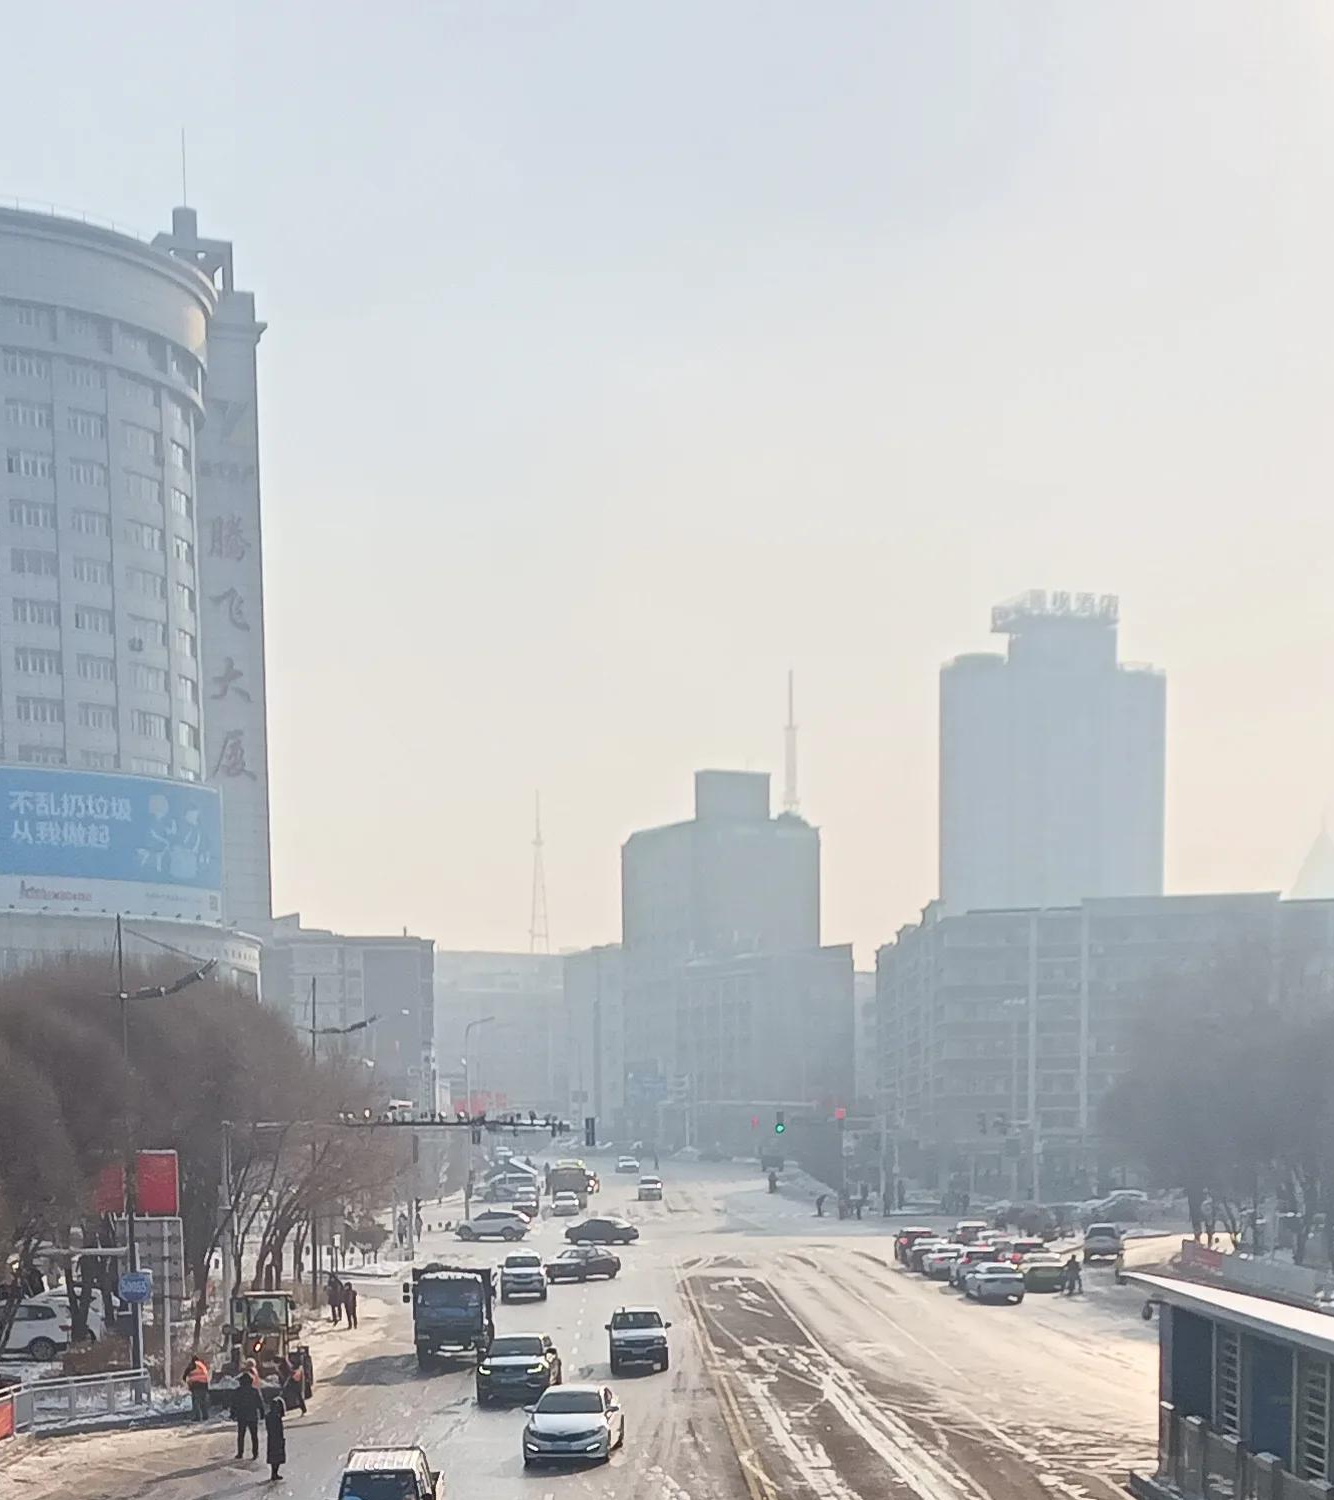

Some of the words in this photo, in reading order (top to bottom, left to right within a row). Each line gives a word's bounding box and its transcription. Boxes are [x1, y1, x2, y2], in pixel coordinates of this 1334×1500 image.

[9, 790, 132, 823] 不乱扔垃圾
[11, 821, 111, 848] 从我做起
